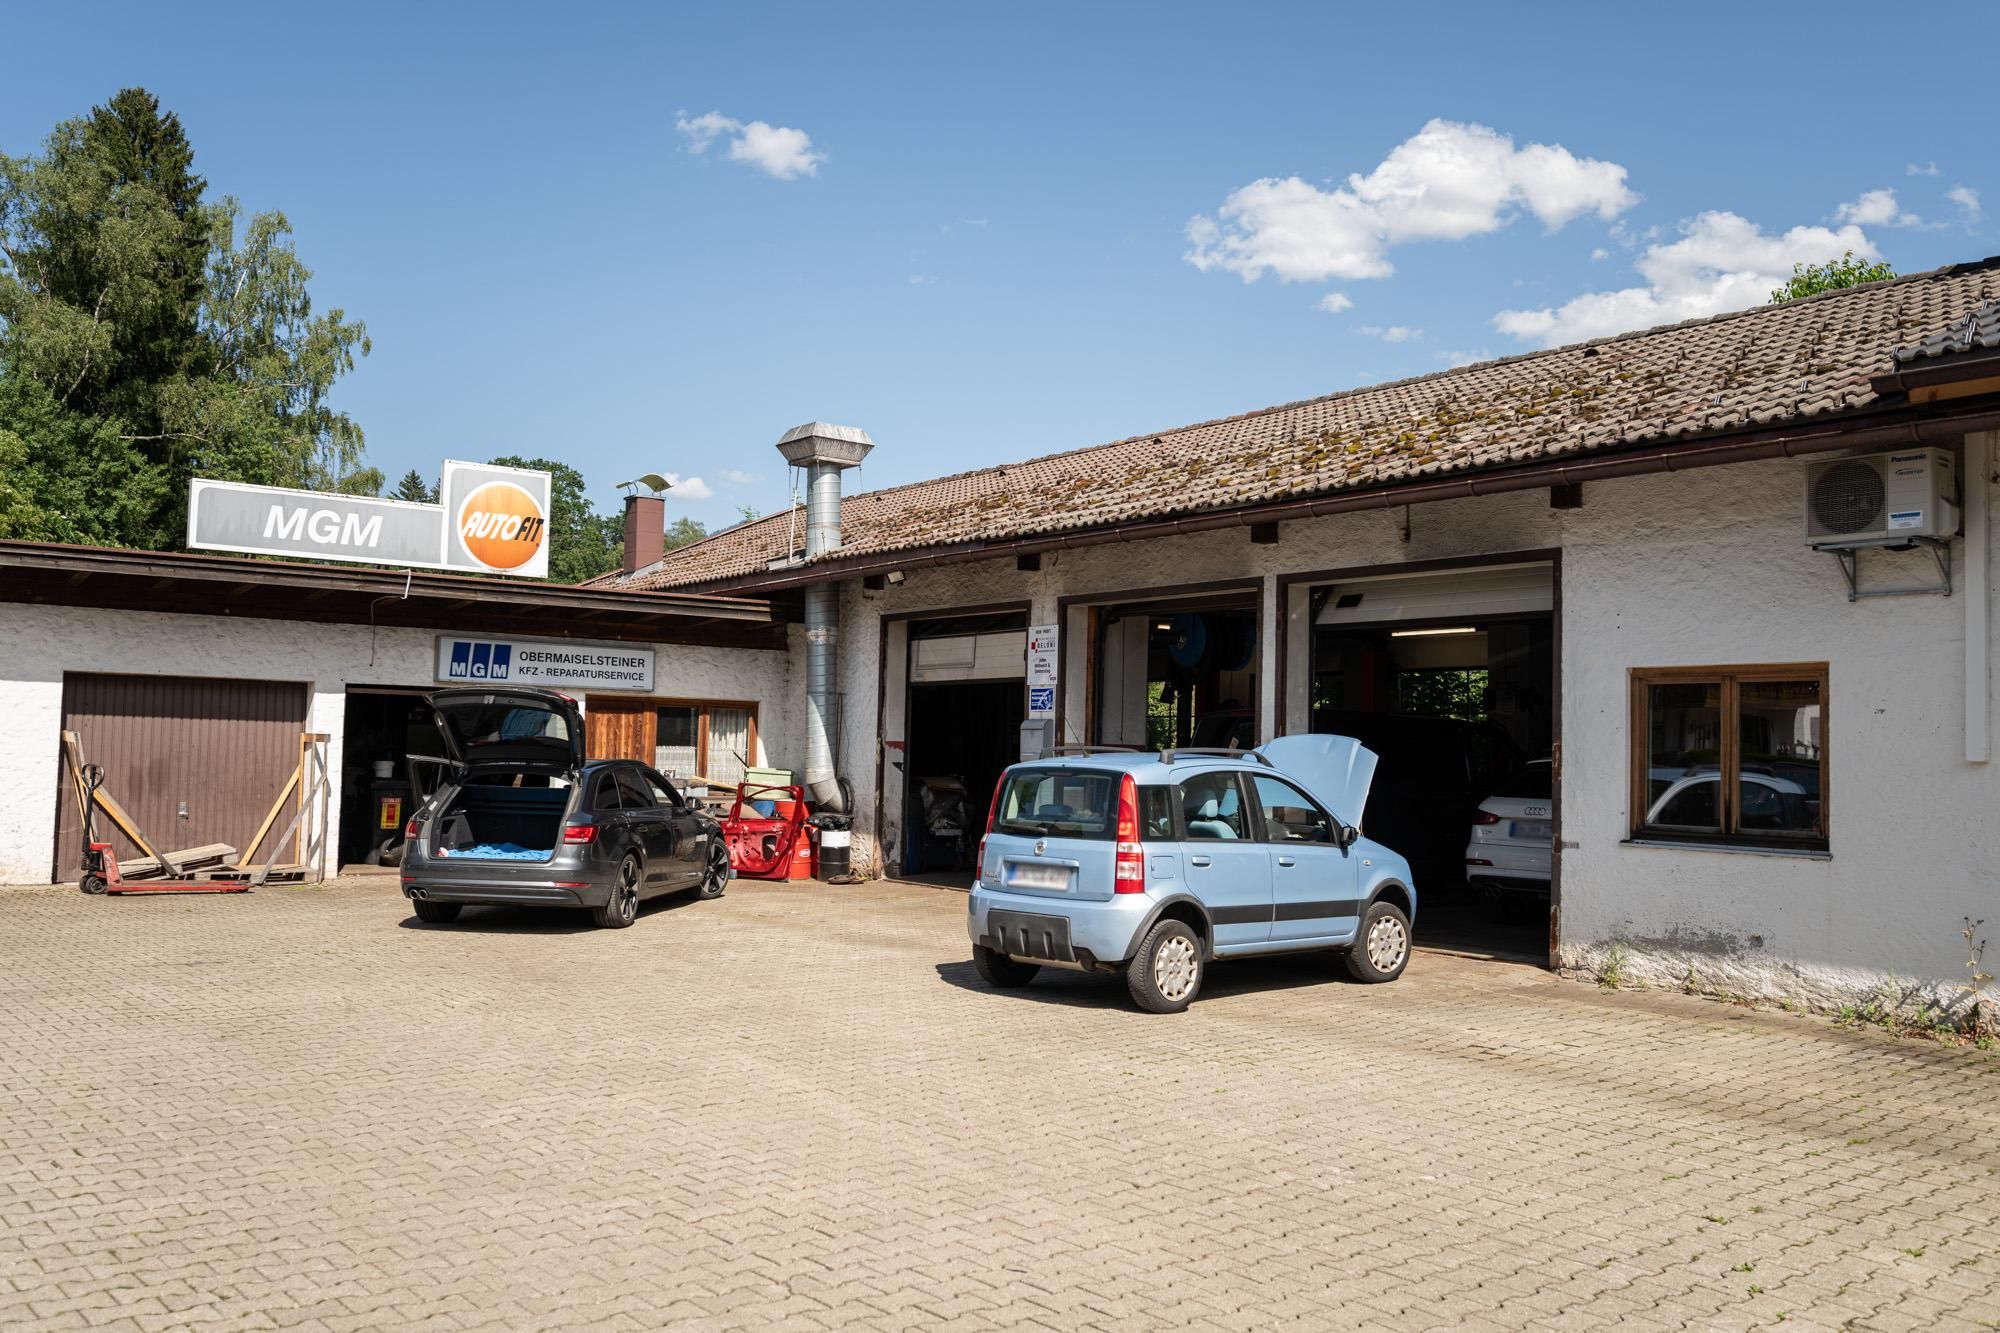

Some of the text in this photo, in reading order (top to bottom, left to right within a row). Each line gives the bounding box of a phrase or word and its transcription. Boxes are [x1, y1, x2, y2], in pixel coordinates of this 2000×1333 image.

[1891, 454, 1926, 462] Panasonic
[263, 504, 384, 548] MGM
[461, 511, 545, 543] AUTOFIT
[519, 651, 645, 668] OBERMAISELSTEINER
[450, 661, 507, 679] MGM
[518, 666, 538, 676] KFZ
[546, 667, 645, 681] REPARATURSERVICE
